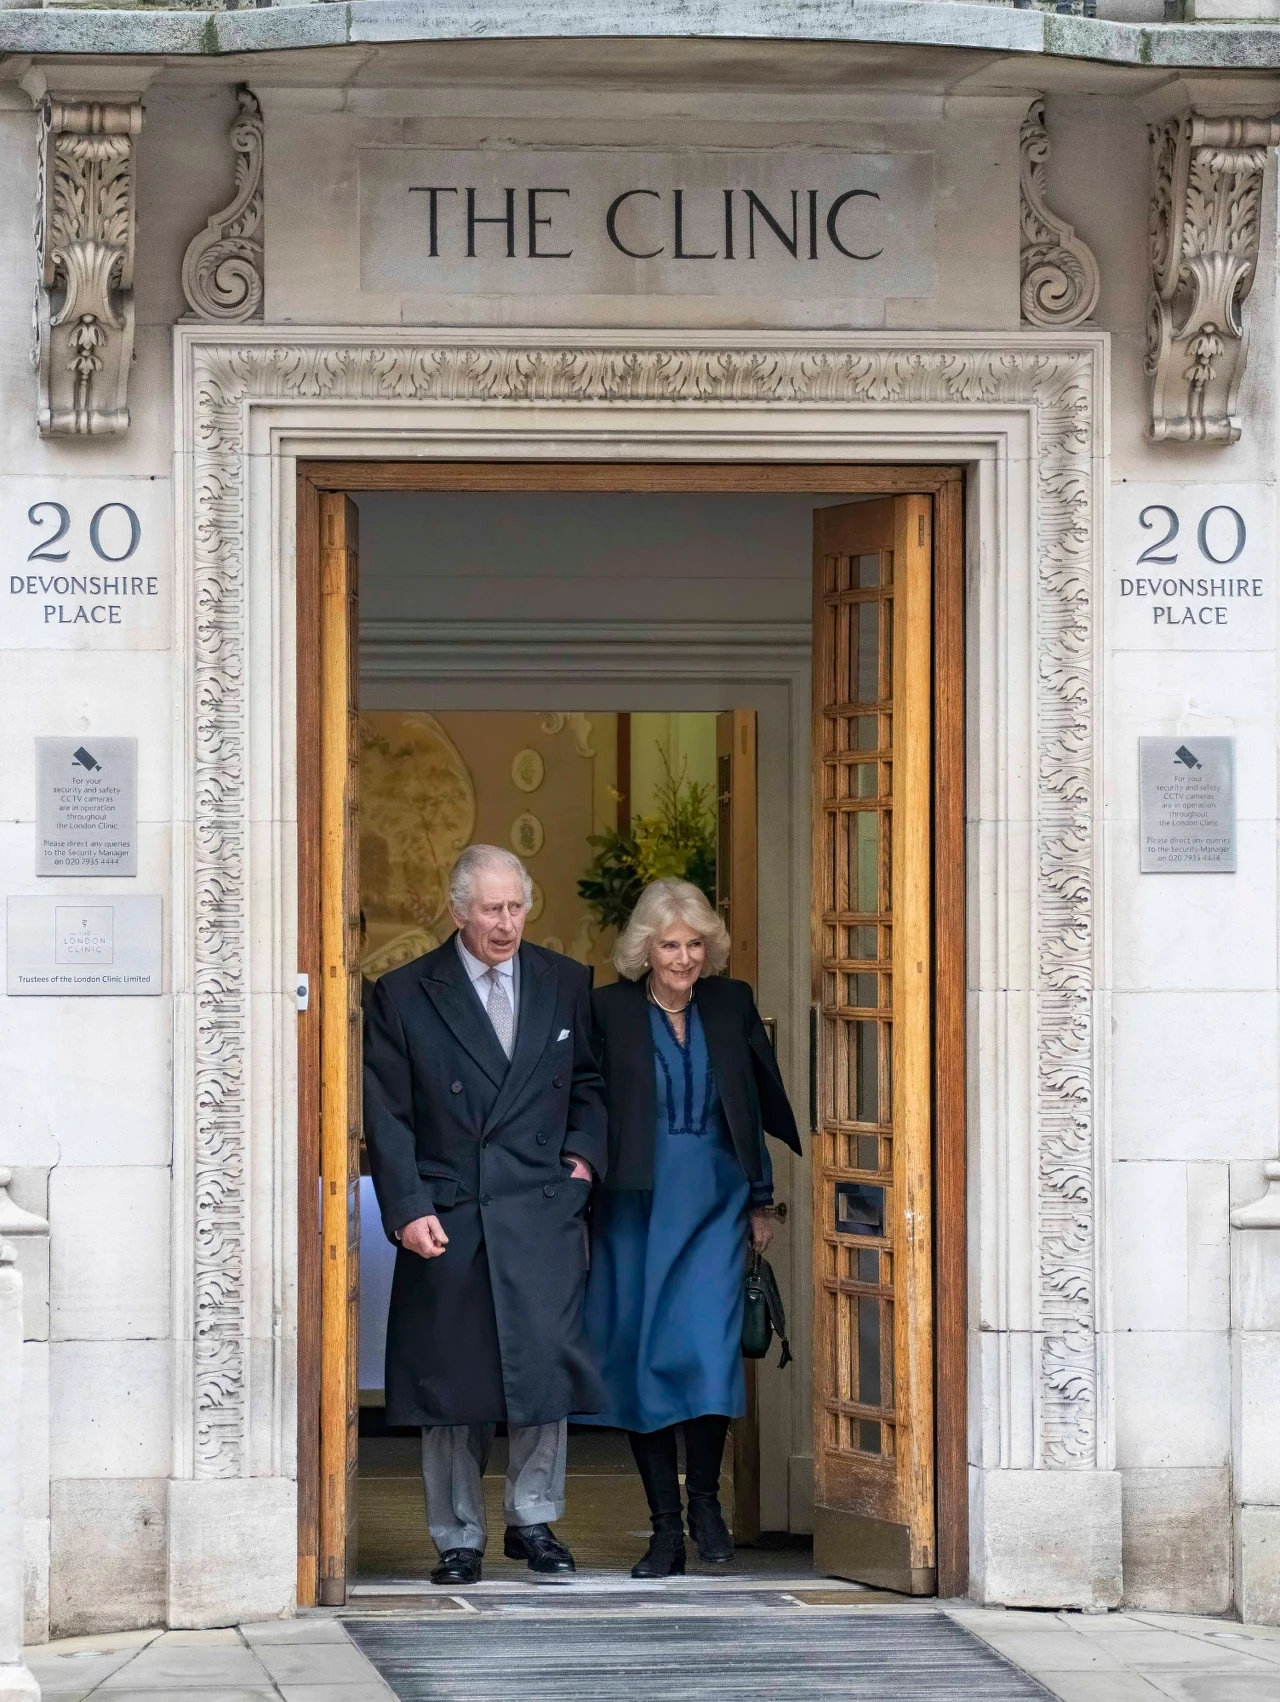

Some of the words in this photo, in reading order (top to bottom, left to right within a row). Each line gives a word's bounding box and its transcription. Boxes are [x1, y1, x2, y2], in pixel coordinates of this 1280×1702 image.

[408, 187, 574, 258] THE
[606, 188, 884, 260] CLINIC
[27, 502, 141, 563] 20
[1136, 504, 1246, 565] 20
[10, 576, 158, 595] DEVONSHIRE
[1120, 579, 1263, 596] DEVONSHIRE
[44, 605, 121, 624] PLACE
[1153, 606, 1228, 625] PLACE
[54, 787, 82, 795] security
[98, 787, 121, 795] safety
[1170, 811, 1208, 819] throughout
[1182, 802, 1216, 810] operation
[68, 849, 97, 857] Security
[98, 850, 129, 858] Manager
[1171, 846, 1198, 854] Security
[1201, 846, 1230, 854] Manager
